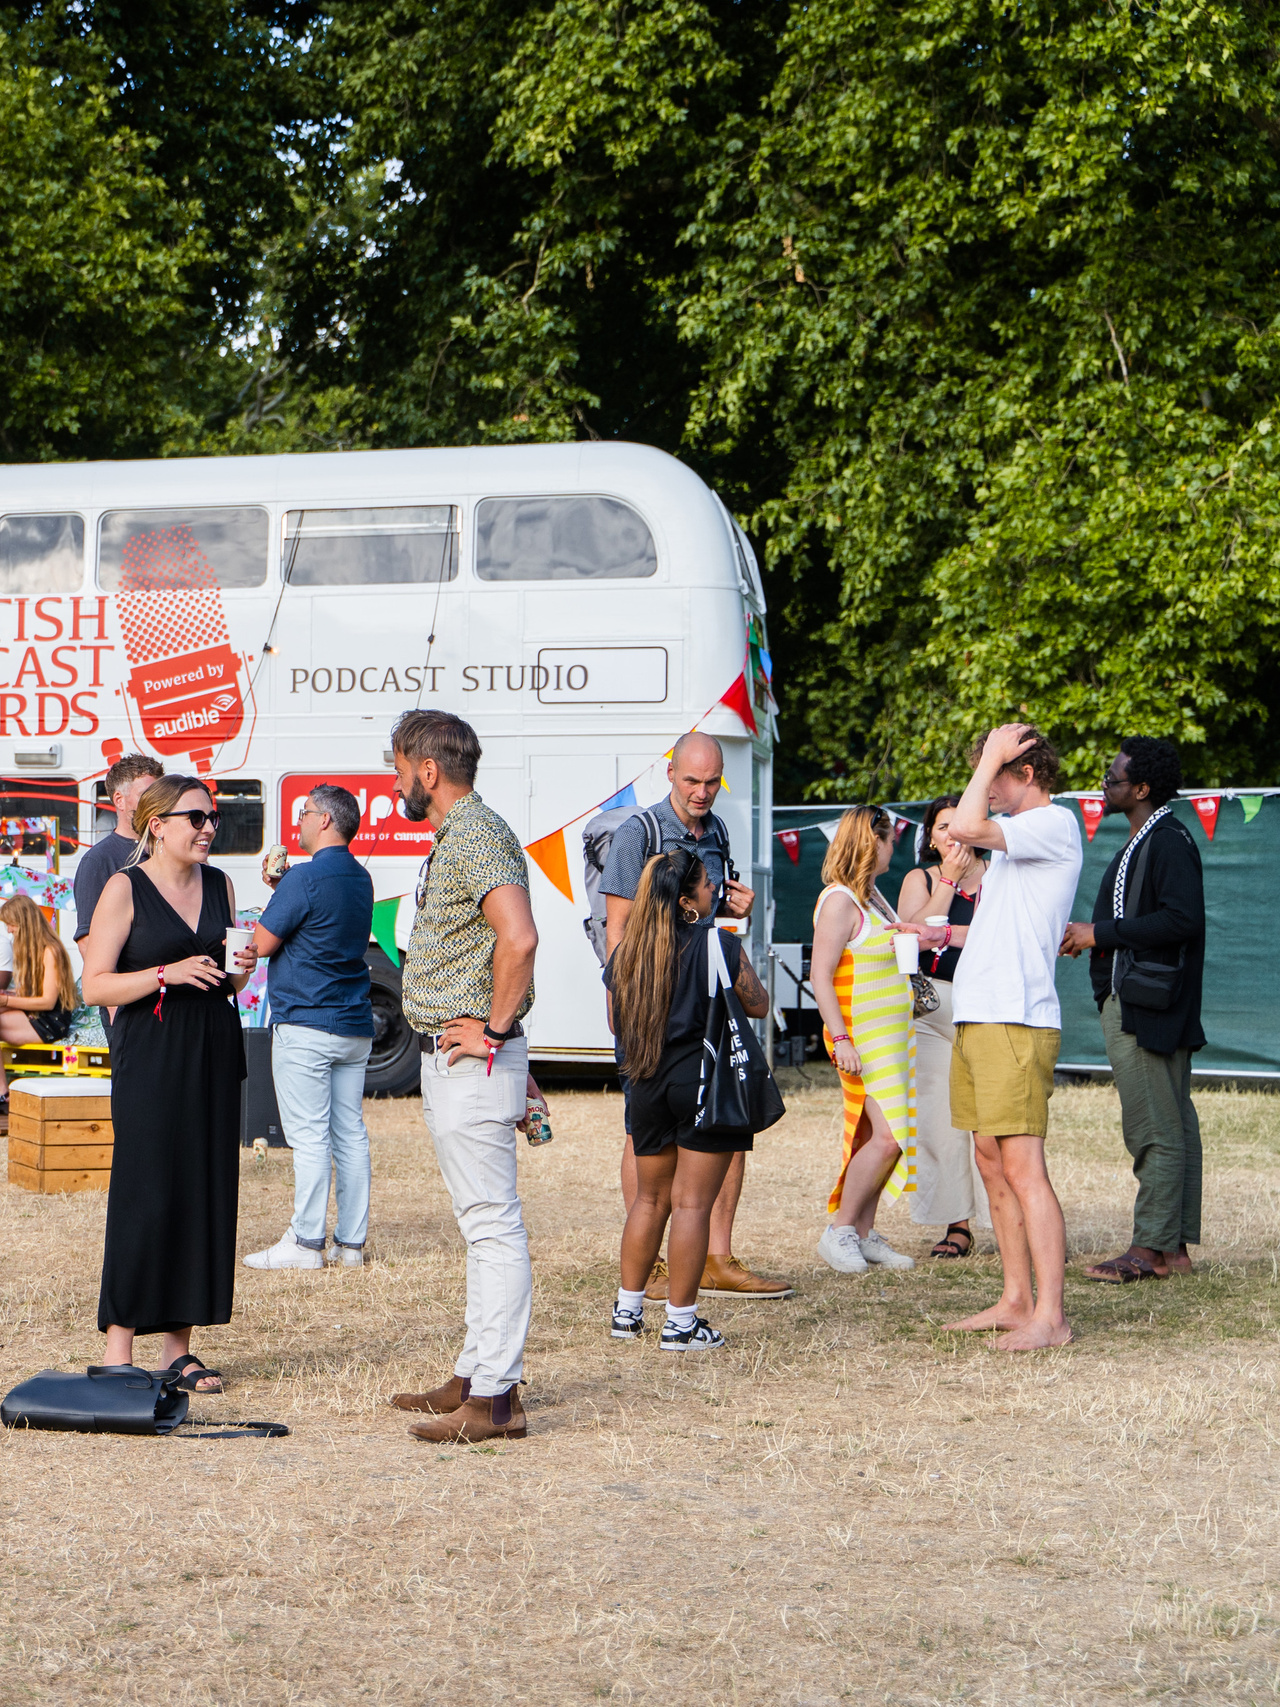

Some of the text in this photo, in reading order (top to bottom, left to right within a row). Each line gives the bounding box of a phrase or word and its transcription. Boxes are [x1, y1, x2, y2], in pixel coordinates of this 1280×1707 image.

[143, 664, 224, 694] Powered by
[289, 664, 589, 693] PODCAST STUDIO
[153, 707, 221, 738] audible
[378, 833, 390, 841] OF
